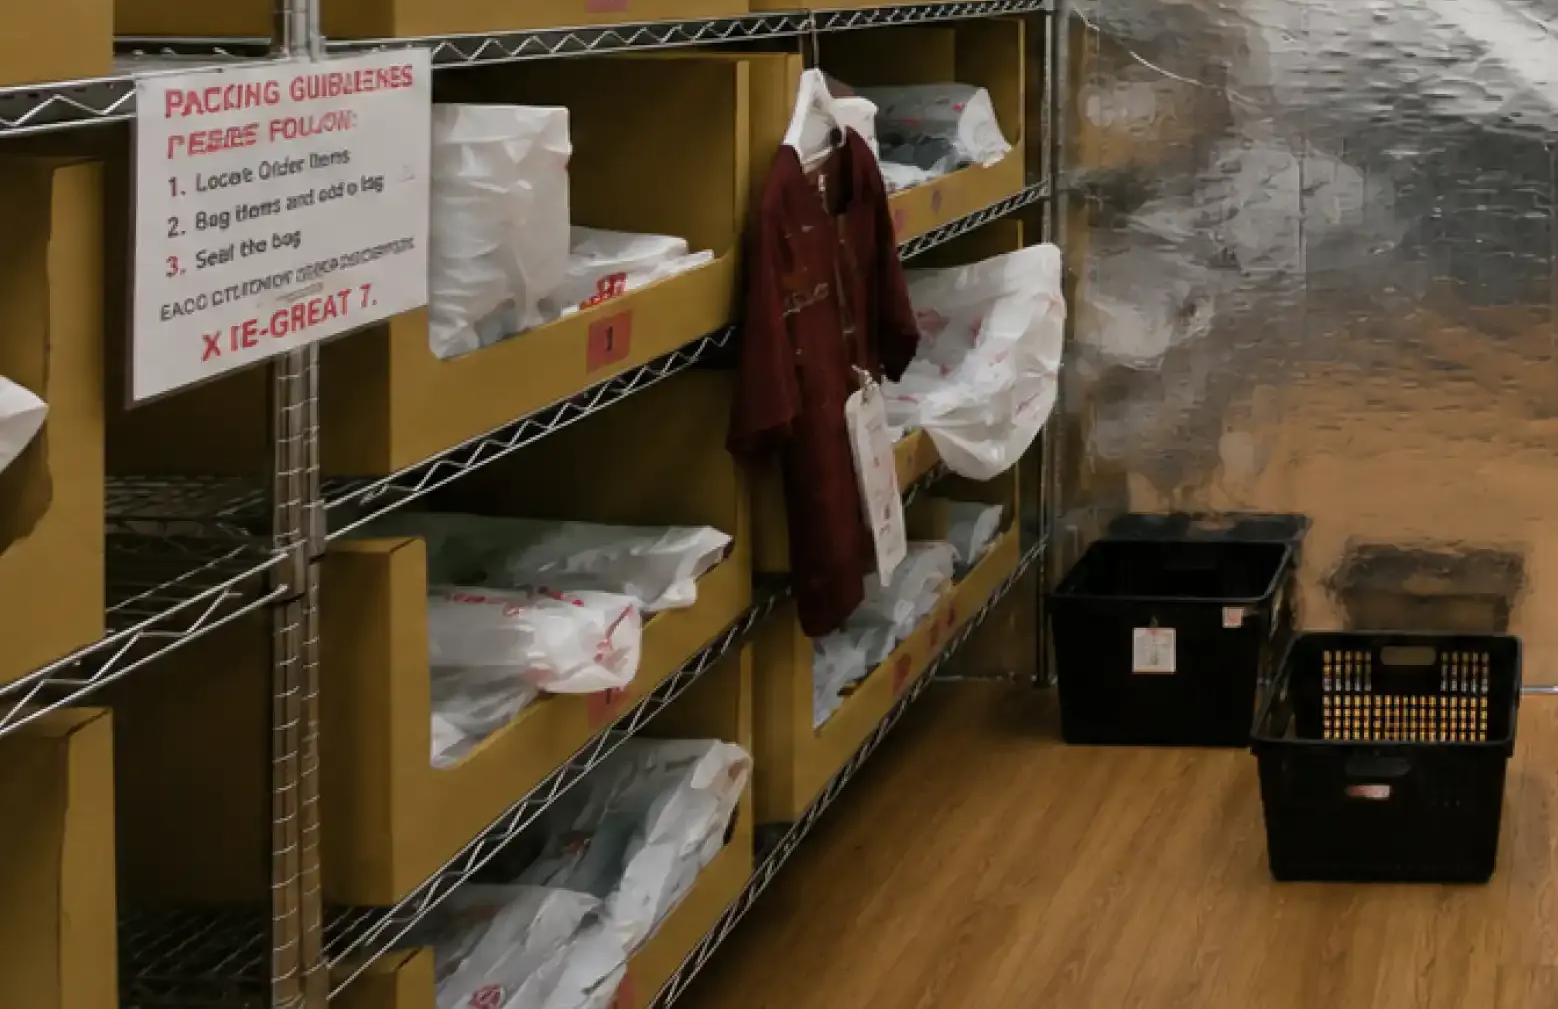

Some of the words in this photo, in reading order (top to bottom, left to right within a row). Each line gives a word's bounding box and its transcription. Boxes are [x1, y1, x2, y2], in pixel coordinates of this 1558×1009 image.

[167, 176, 186, 197] 1.
[167, 216, 186, 238] 2.
[165, 255, 186, 278] 3.
